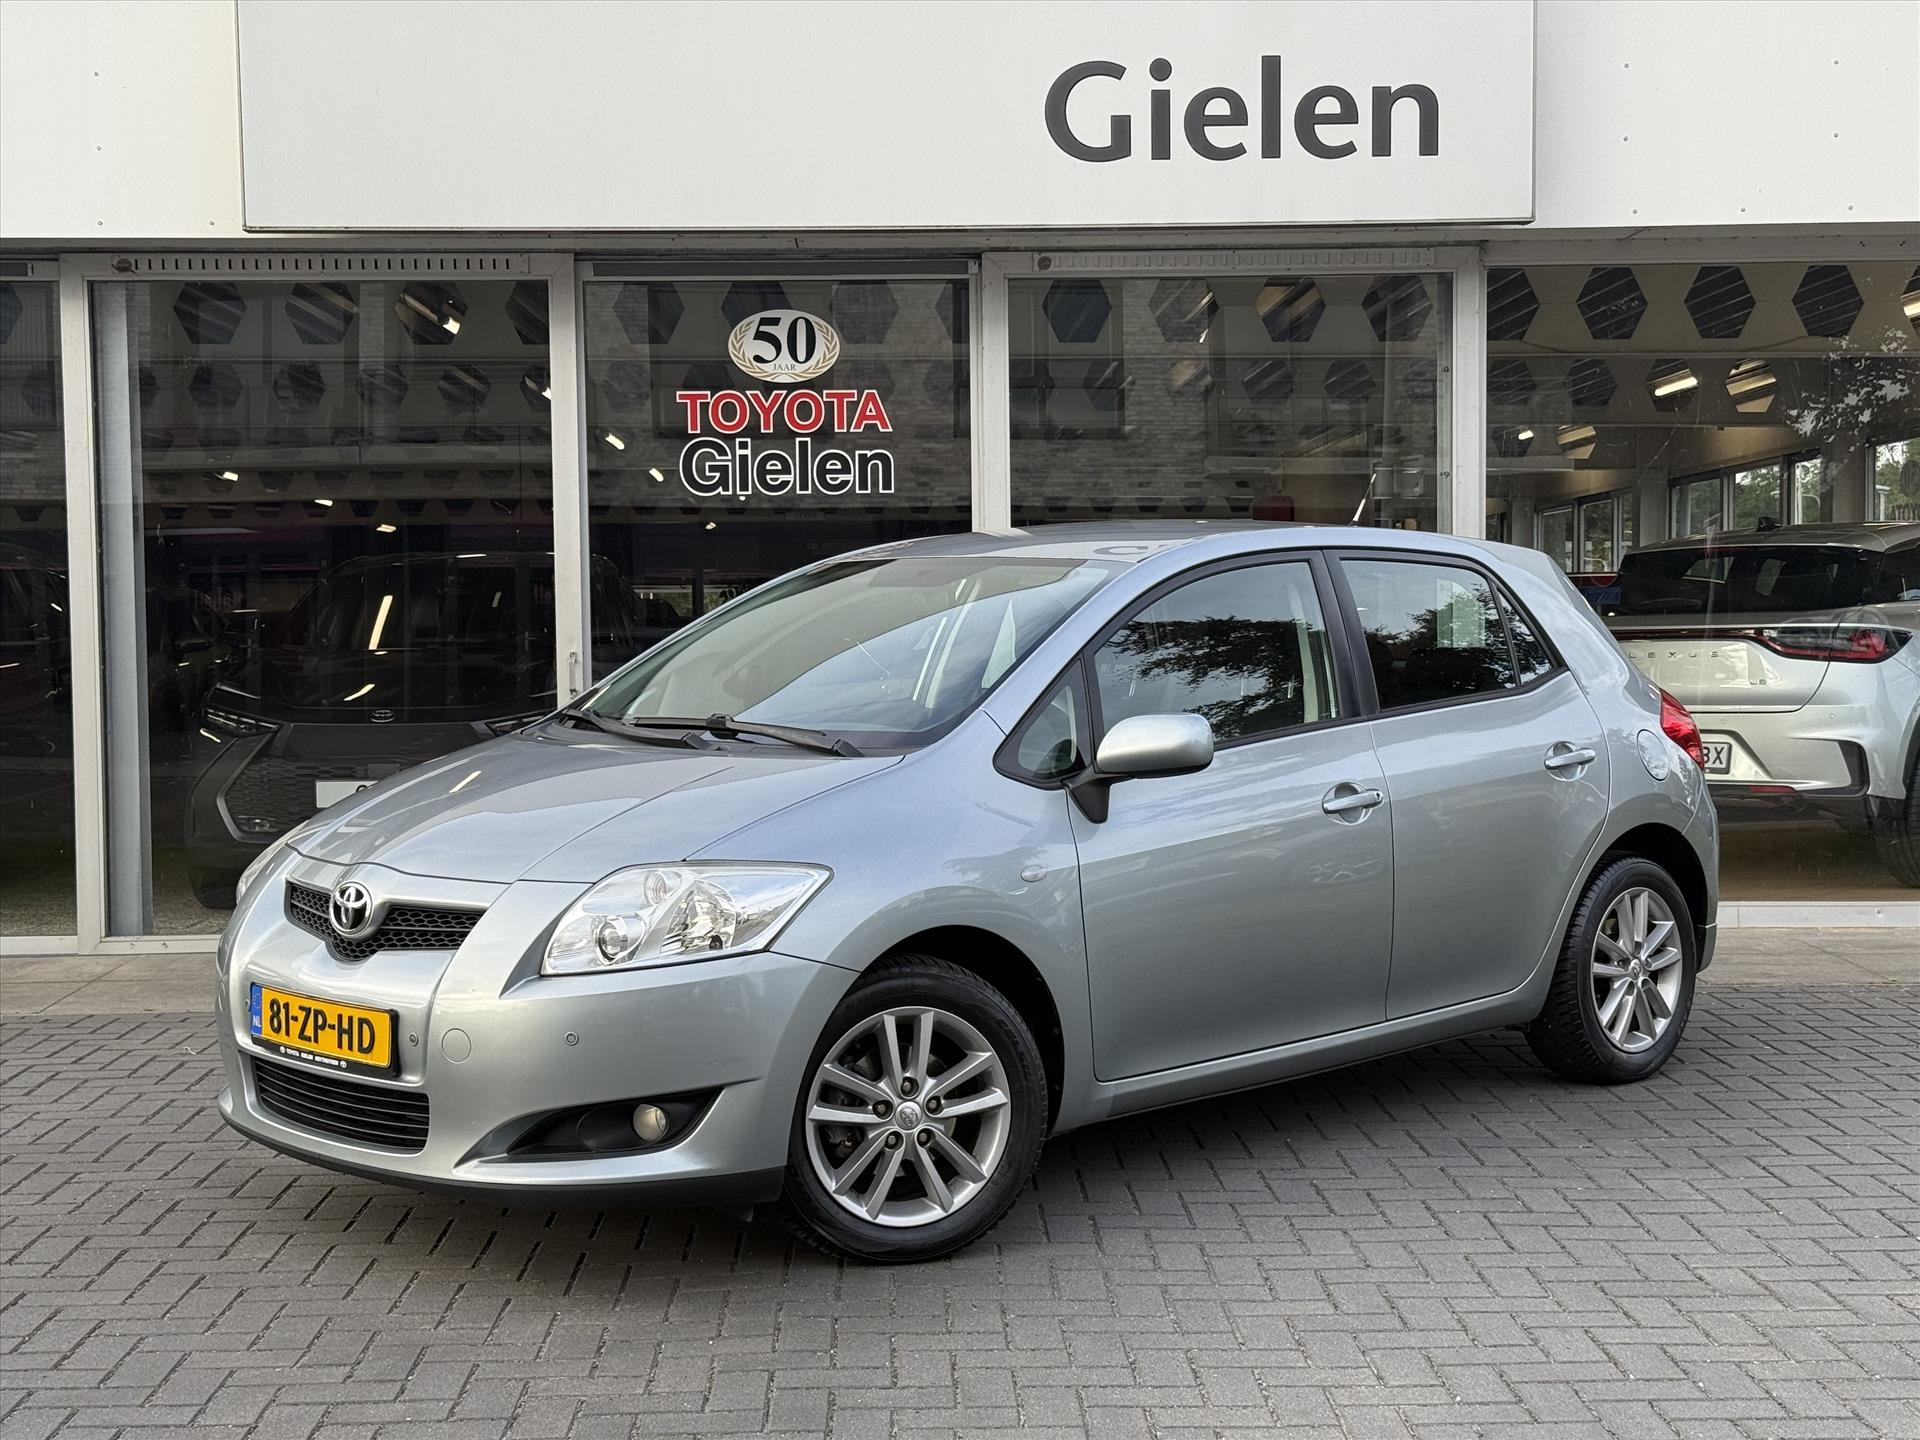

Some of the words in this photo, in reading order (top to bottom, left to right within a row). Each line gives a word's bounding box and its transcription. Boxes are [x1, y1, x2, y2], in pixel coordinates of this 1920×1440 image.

[1044, 54, 1440, 163] Gielen
[752, 316, 817, 364] 50
[772, 363, 797, 372] JAAR
[676, 389, 894, 434] TOYOTA
[679, 436, 896, 497] Gielen
[1628, 650, 1719, 659] LEXUS
[252, 1014, 262, 1028] NL
[269, 998, 375, 1054] 81-ZP-HD
